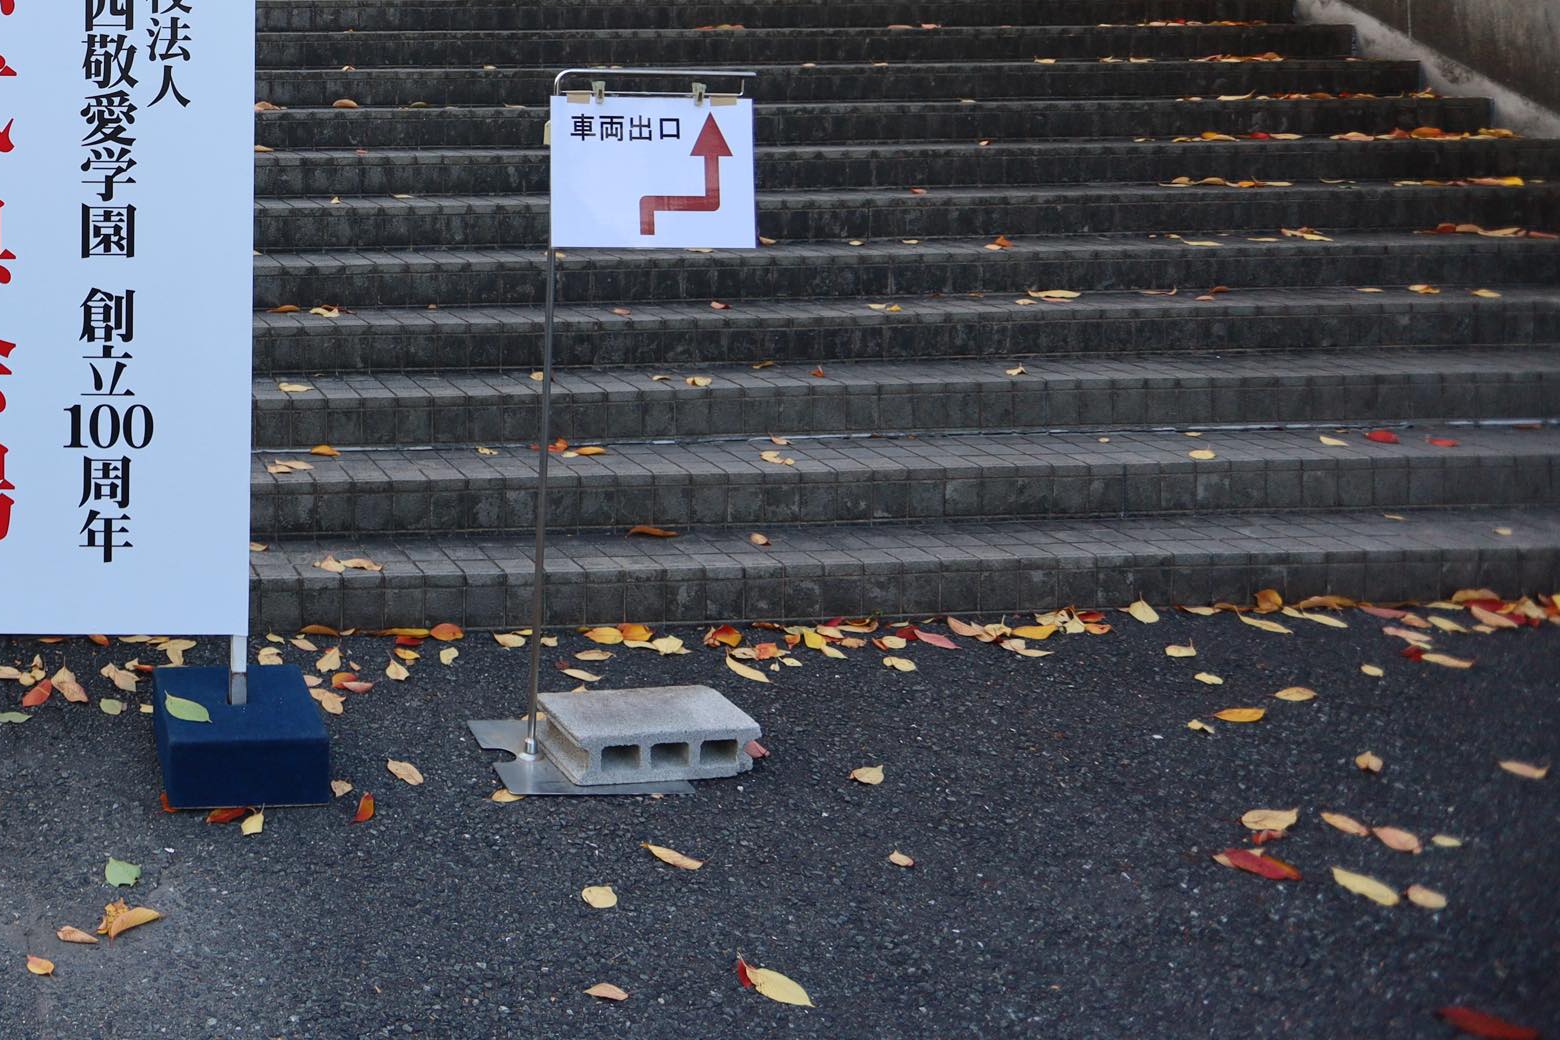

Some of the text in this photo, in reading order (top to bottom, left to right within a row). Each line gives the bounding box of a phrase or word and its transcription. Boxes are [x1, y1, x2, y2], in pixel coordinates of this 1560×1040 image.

[570, 113, 681, 142] 車両出口
[63, 287, 154, 564] 創立100周年
